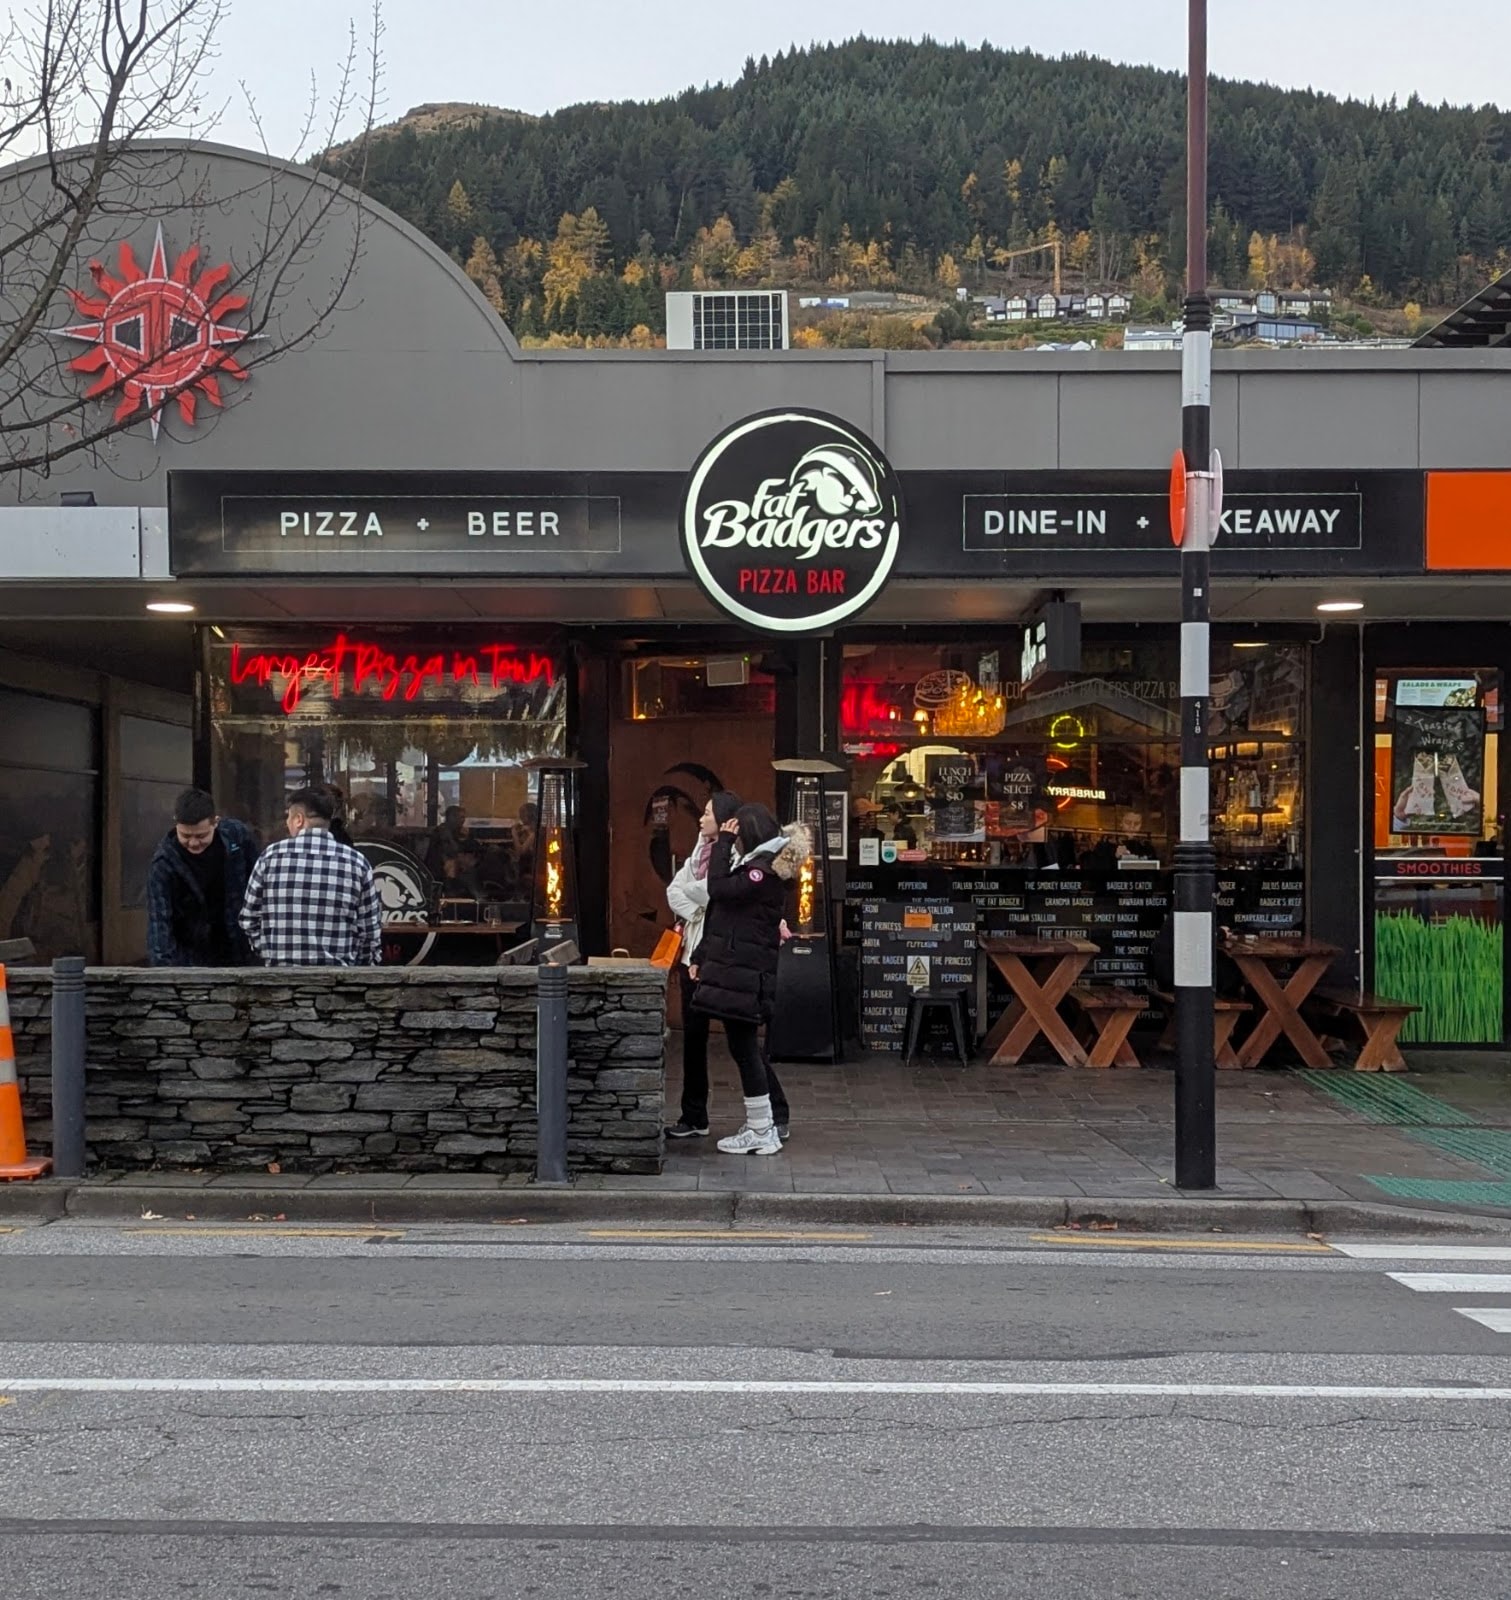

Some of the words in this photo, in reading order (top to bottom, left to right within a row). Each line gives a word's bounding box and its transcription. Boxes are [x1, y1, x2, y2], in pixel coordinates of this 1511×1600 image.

[751, 478, 808, 520] Fat
[280, 511, 383, 536] PIZZA
[467, 511, 560, 536] BEER
[700, 500, 886, 560] Badgers
[983, 509, 1107, 535] DINE-IN
[1220, 508, 1341, 534] KEAWAY
[739, 569, 797, 594] PIZZA
[806, 569, 845, 594] BAR
[230, 633, 353, 714] Largest
[355, 643, 446, 702] Pizza
[453, 648, 479, 687] in
[480, 641, 556, 690] Town
[1133, 681, 1166, 699] PIZZA
[938, 767, 972, 776] LUNCH
[941, 775, 969, 785] MENU
[1004, 773, 1032, 782] PIZZA
[1003, 785, 1033, 794] SLICE
[1010, 801, 1024, 810] $8
[1397, 862, 1482, 874] SMOOTHIES
